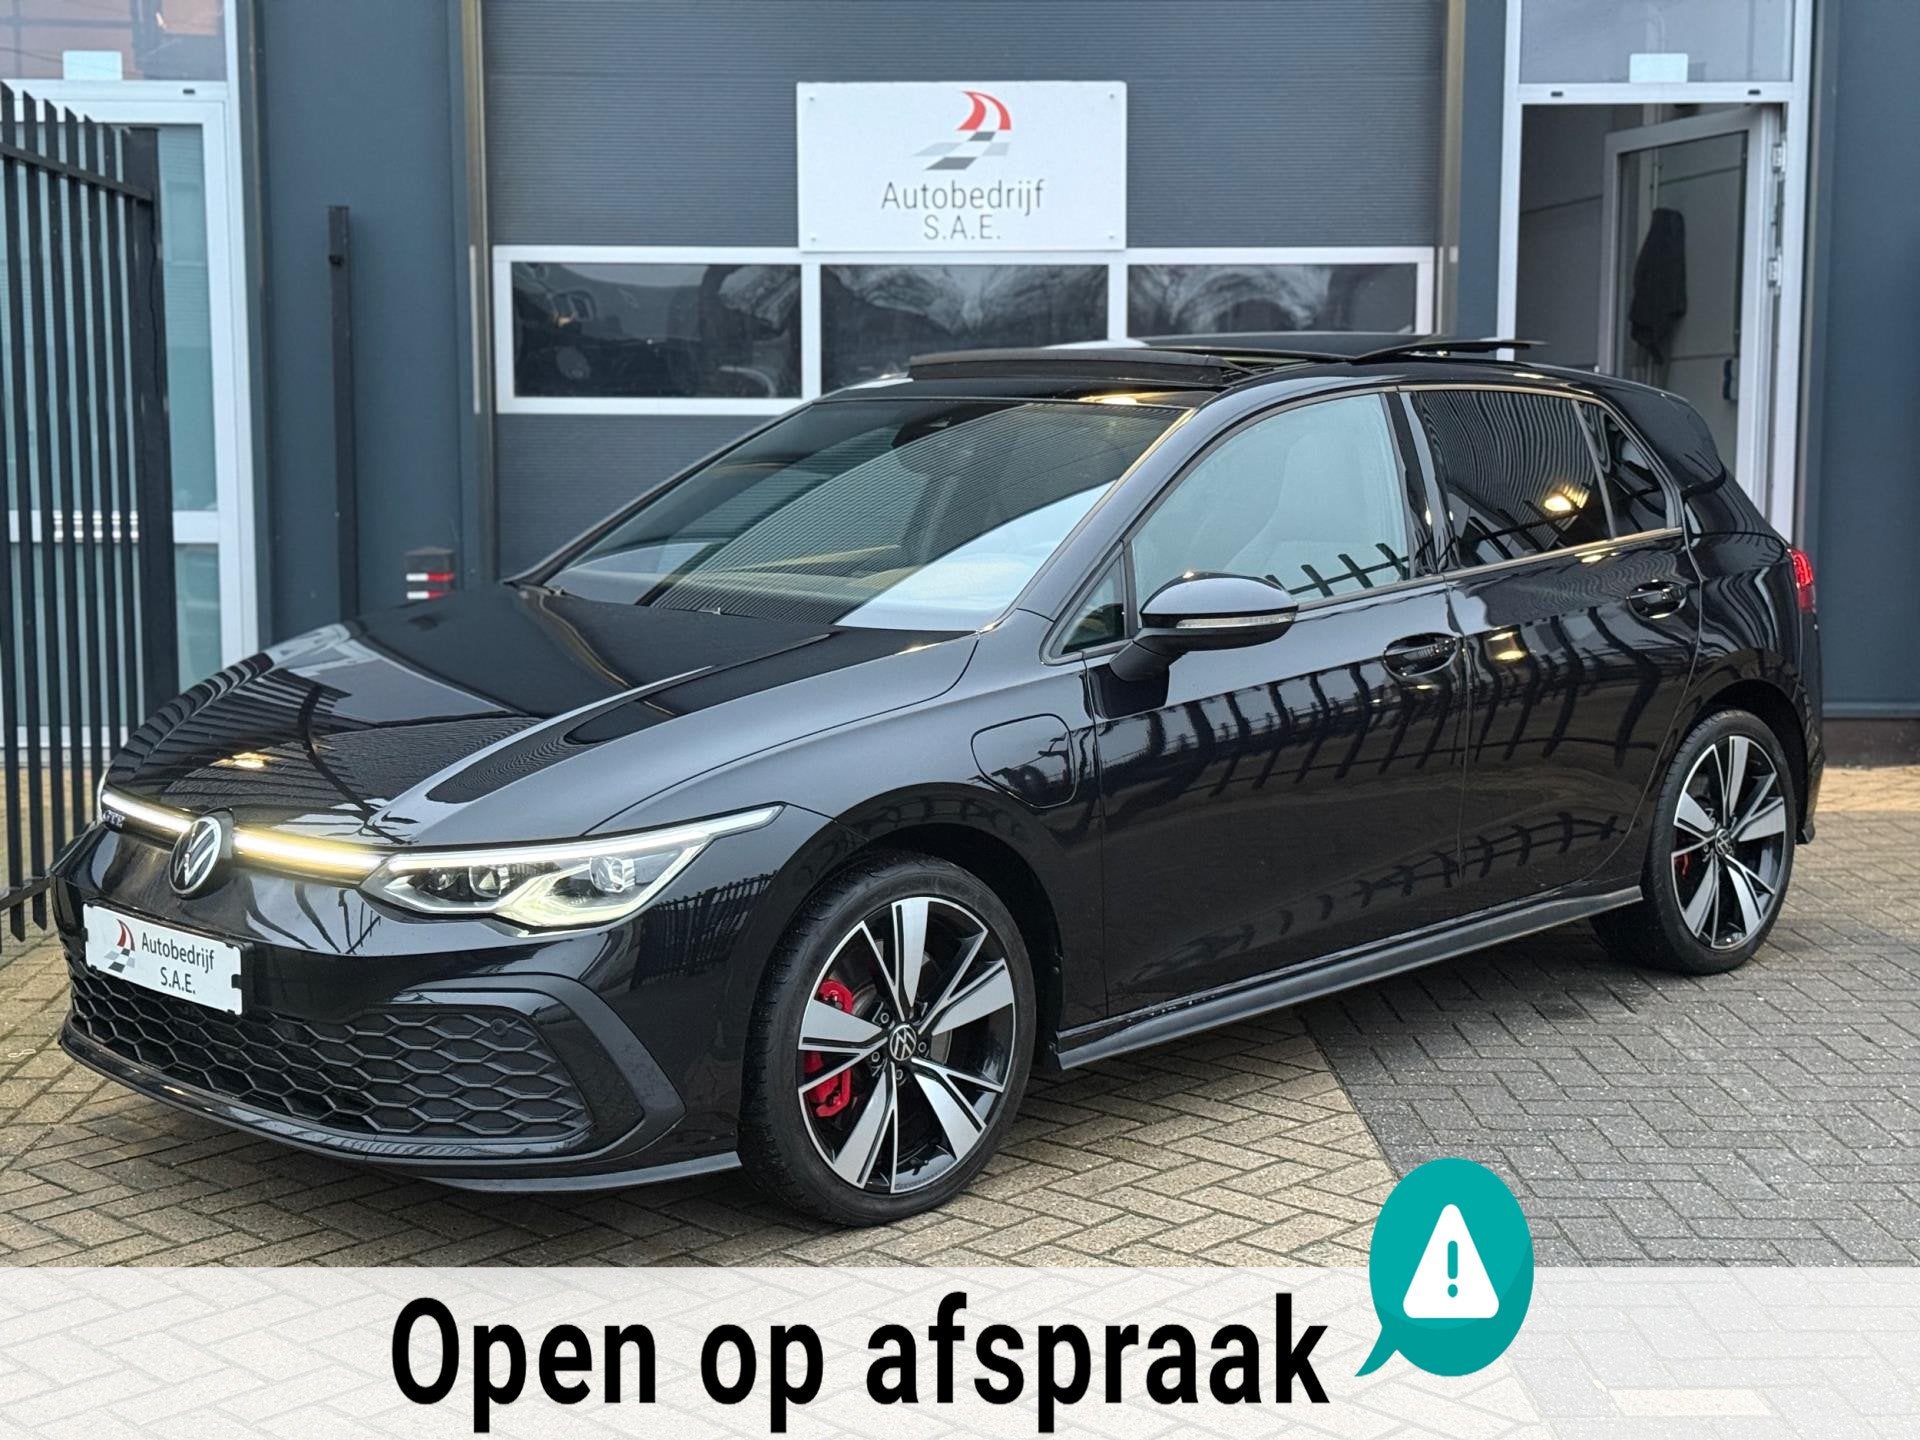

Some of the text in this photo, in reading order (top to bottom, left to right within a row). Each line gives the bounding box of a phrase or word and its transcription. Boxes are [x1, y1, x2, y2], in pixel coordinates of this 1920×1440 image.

[881, 179, 1045, 216] Autobedrijf
[923, 214, 1001, 241] S.A.E.
[141, 932, 215, 974] Autobedrijf
[160, 966, 196, 995] S.A.E.
